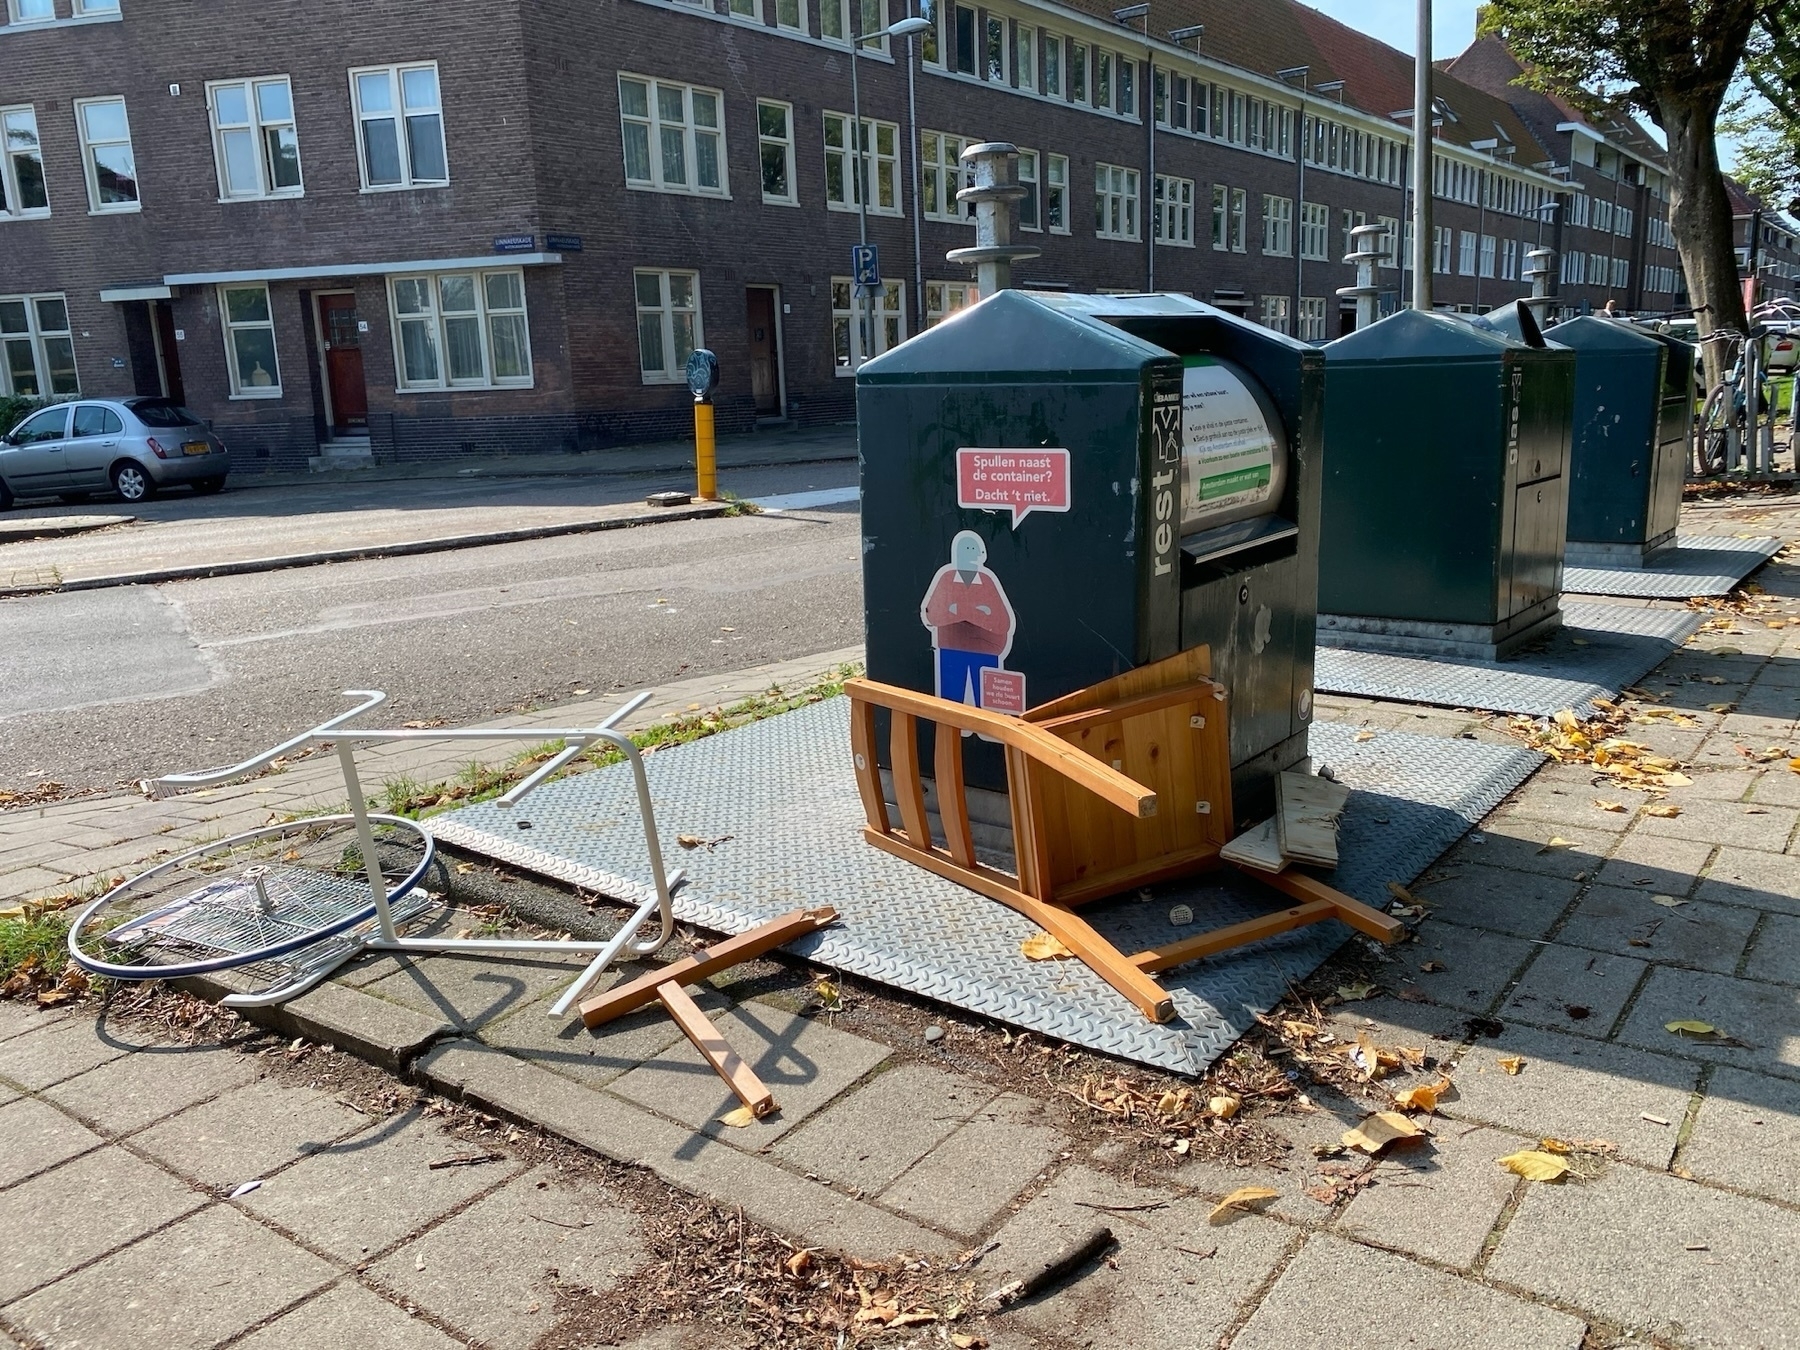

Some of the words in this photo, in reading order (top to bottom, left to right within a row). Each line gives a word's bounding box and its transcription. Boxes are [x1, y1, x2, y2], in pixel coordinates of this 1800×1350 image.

[859, 249, 872, 268] P
[1509, 406, 1519, 465] glas
[974, 455, 1015, 470] Spullen
[1019, 457, 1051, 468] naast
[973, 469, 987, 480] de
[991, 470, 1052, 482] container?
[975, 489, 1008, 500] Dacht
[1012, 490, 1021, 501] 't
[1024, 490, 1050, 502] niet.
[1152, 468, 1174, 577] rest
[994, 677, 1012, 685] Samen
[992, 684, 1013, 692] houden
[1004, 692, 1020, 700] buurt
